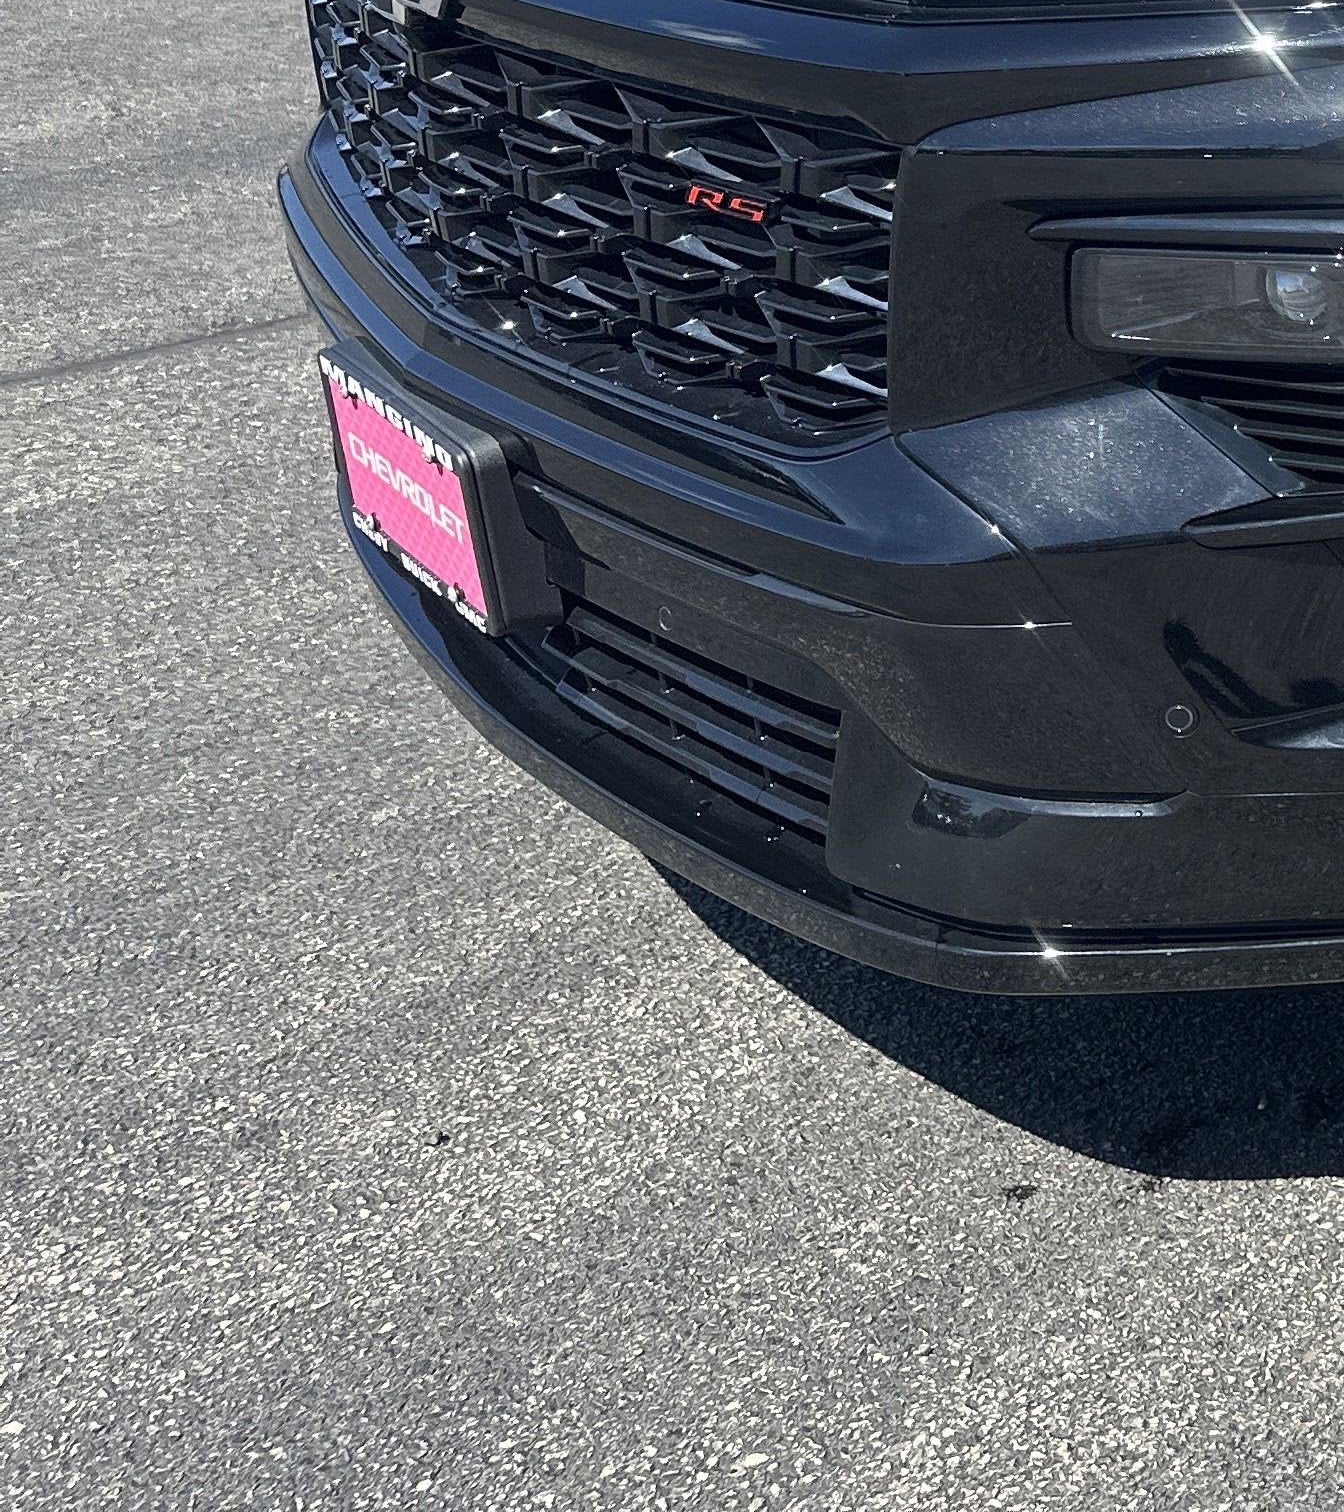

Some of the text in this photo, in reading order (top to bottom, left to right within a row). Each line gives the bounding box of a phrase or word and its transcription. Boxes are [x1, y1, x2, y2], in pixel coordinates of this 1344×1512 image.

[687, 185, 766, 222] RS
[319, 354, 453, 471] MANGINO
[347, 431, 465, 543] CHEVROLET
